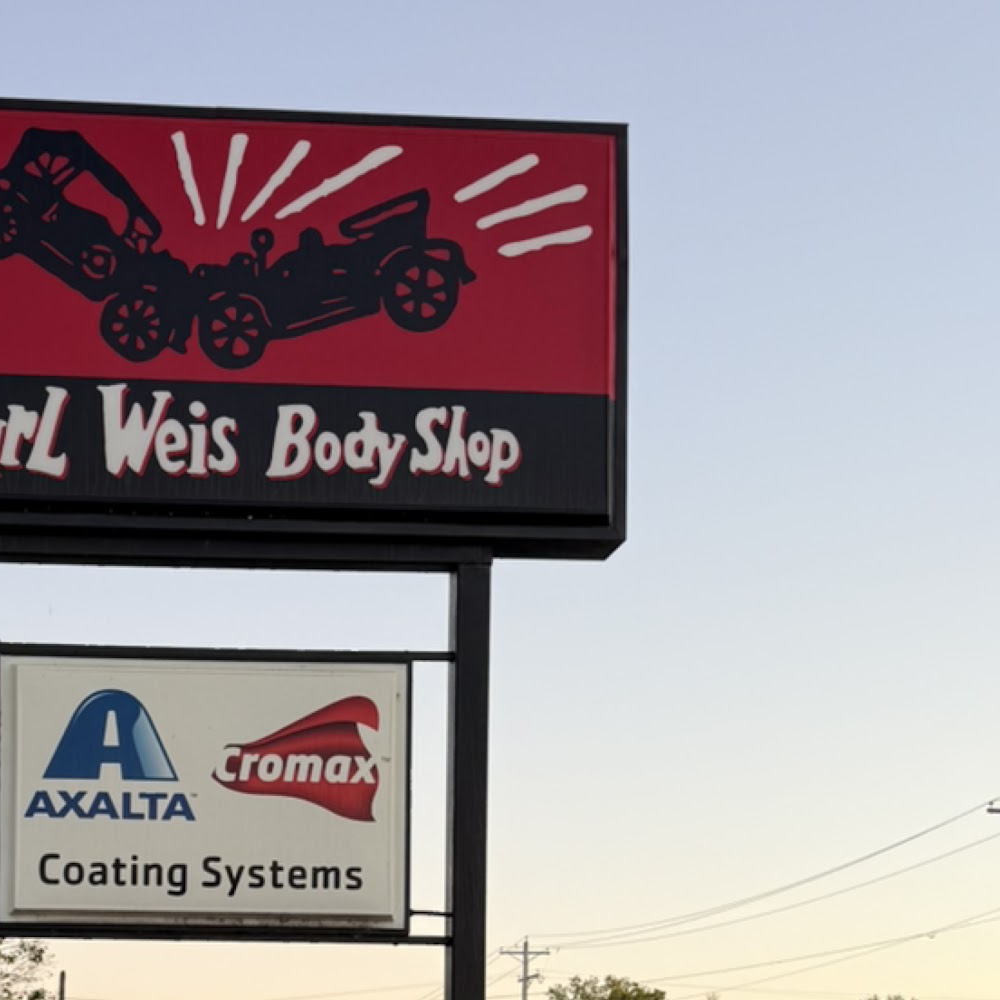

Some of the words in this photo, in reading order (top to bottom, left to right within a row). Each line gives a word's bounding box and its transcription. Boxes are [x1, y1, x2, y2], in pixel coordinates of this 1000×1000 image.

[98, 383, 239, 482] Weis
[266, 404, 406, 488] Body
[410, 405, 522, 486] Shop
[24, 790, 197, 821] AXALTA
[38, 853, 188, 896] Coating
[202, 856, 363, 897] Systems
